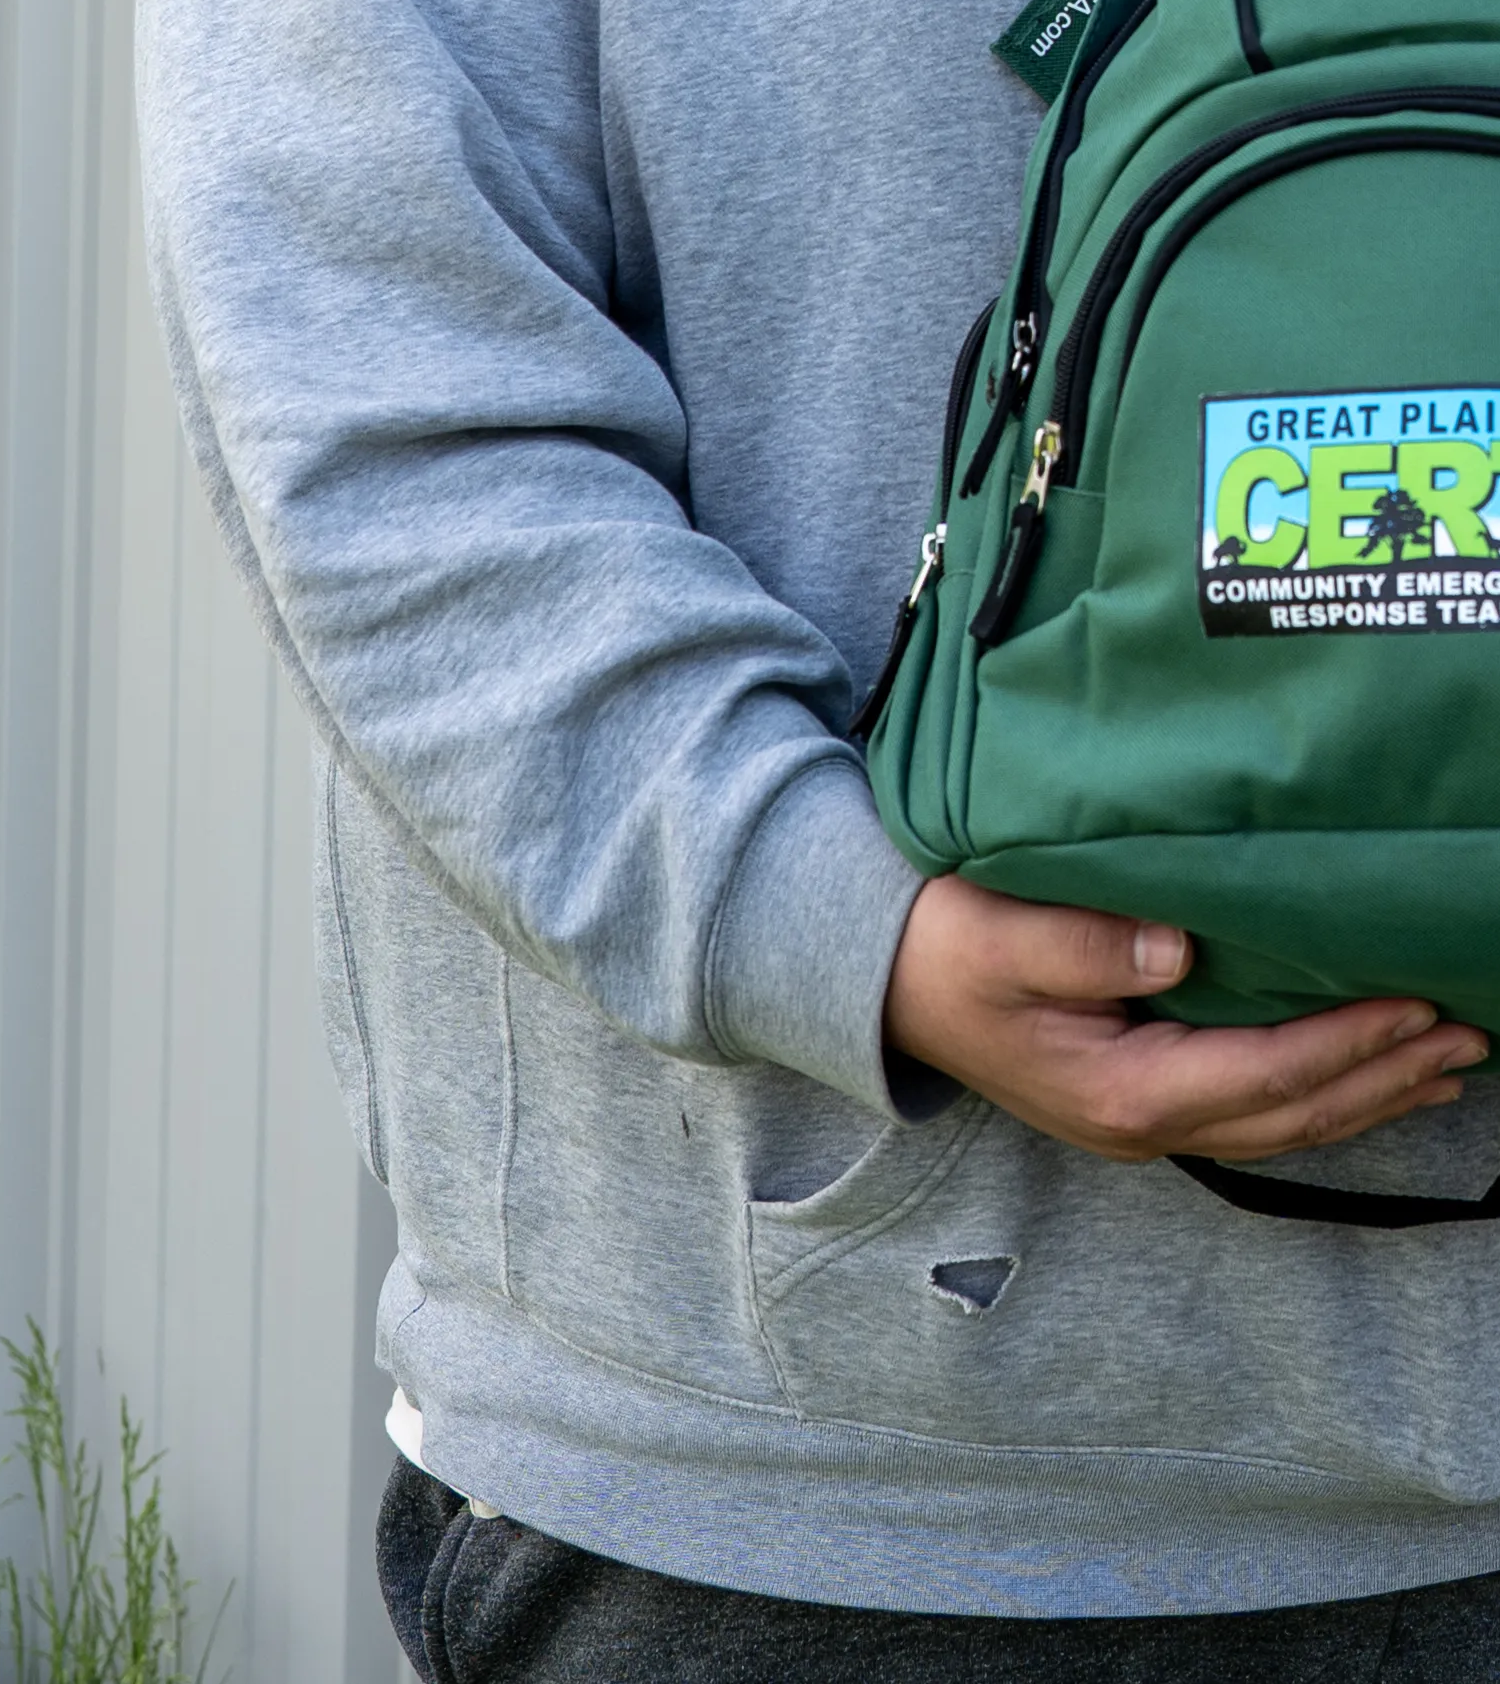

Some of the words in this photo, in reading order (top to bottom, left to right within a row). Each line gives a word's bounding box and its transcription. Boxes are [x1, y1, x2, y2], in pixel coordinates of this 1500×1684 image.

[1247, 404, 1380, 442] GREAT
[1206, 573, 1386, 604] COMMUNITY
[1269, 601, 1428, 629] RESPONSE
